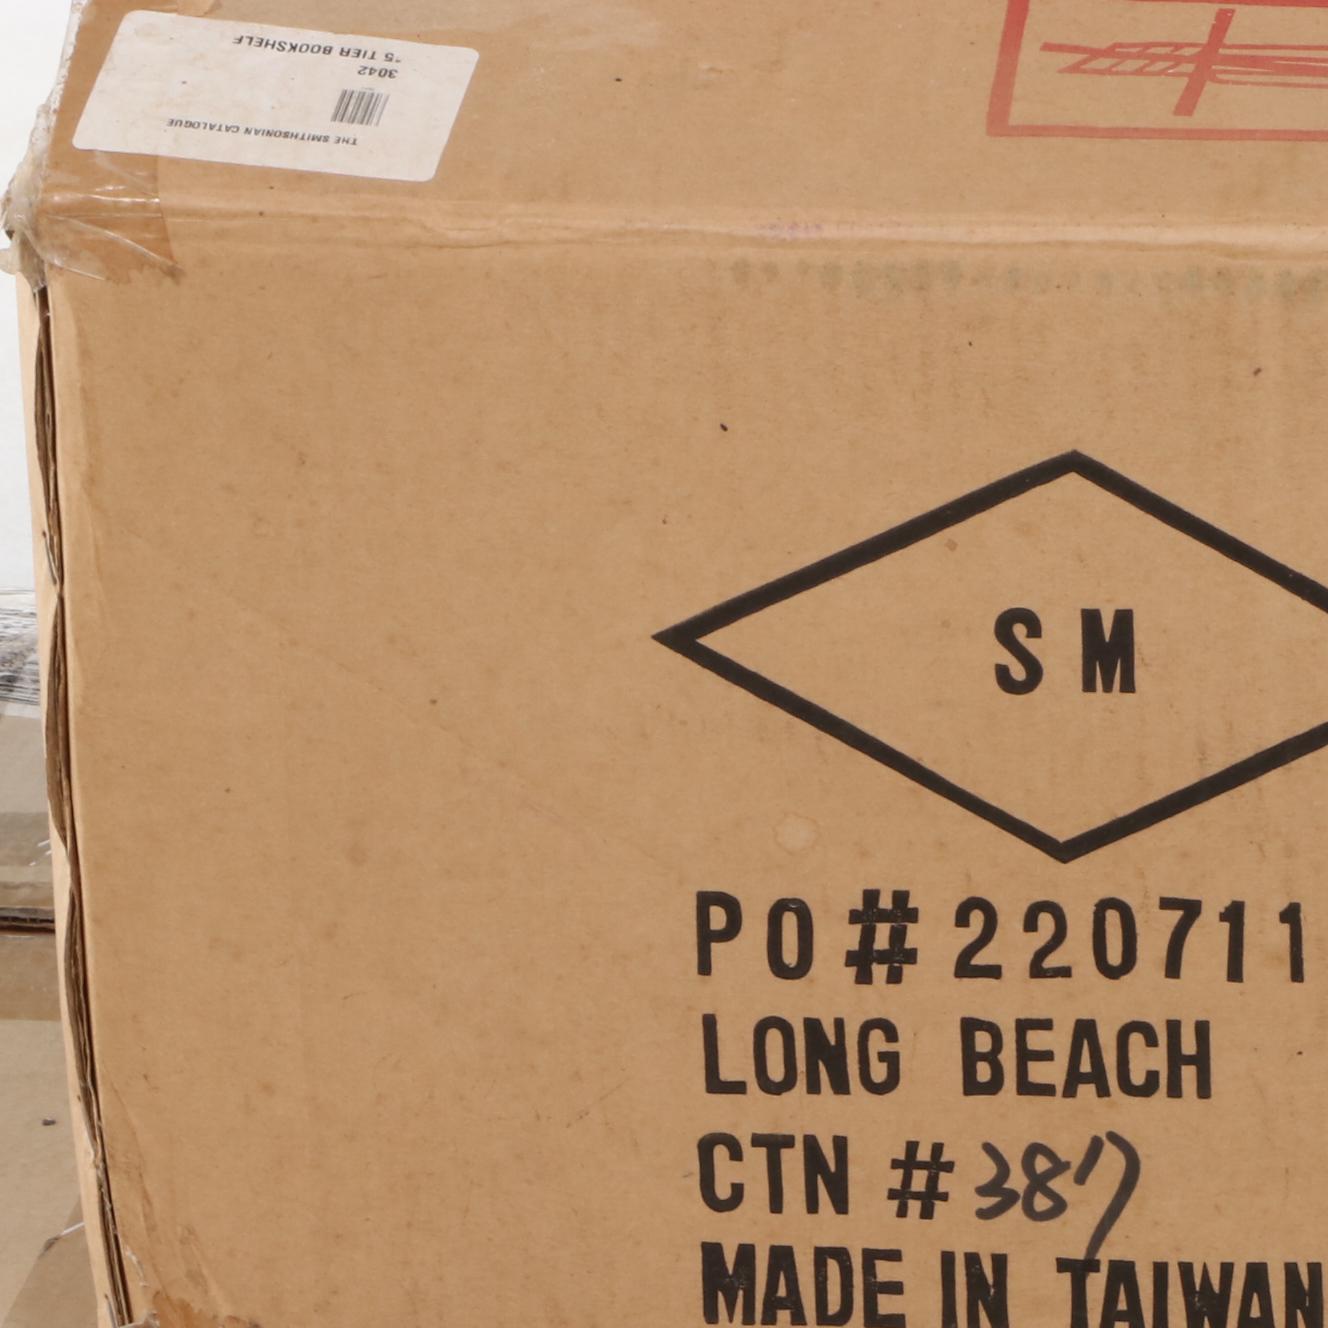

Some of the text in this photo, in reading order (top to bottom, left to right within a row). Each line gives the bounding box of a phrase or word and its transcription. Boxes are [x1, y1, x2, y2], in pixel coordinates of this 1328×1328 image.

[232, 35, 332, 55] BOOKSHELF
[339, 45, 378, 60] TIER
[357, 65, 398, 79] 3042
[167, 119, 358, 146] THE SMITHSONIAN CATALOGUE
[702, 1013, 1212, 1099] LONG BEACH
[696, 1132, 849, 1215] CTN
